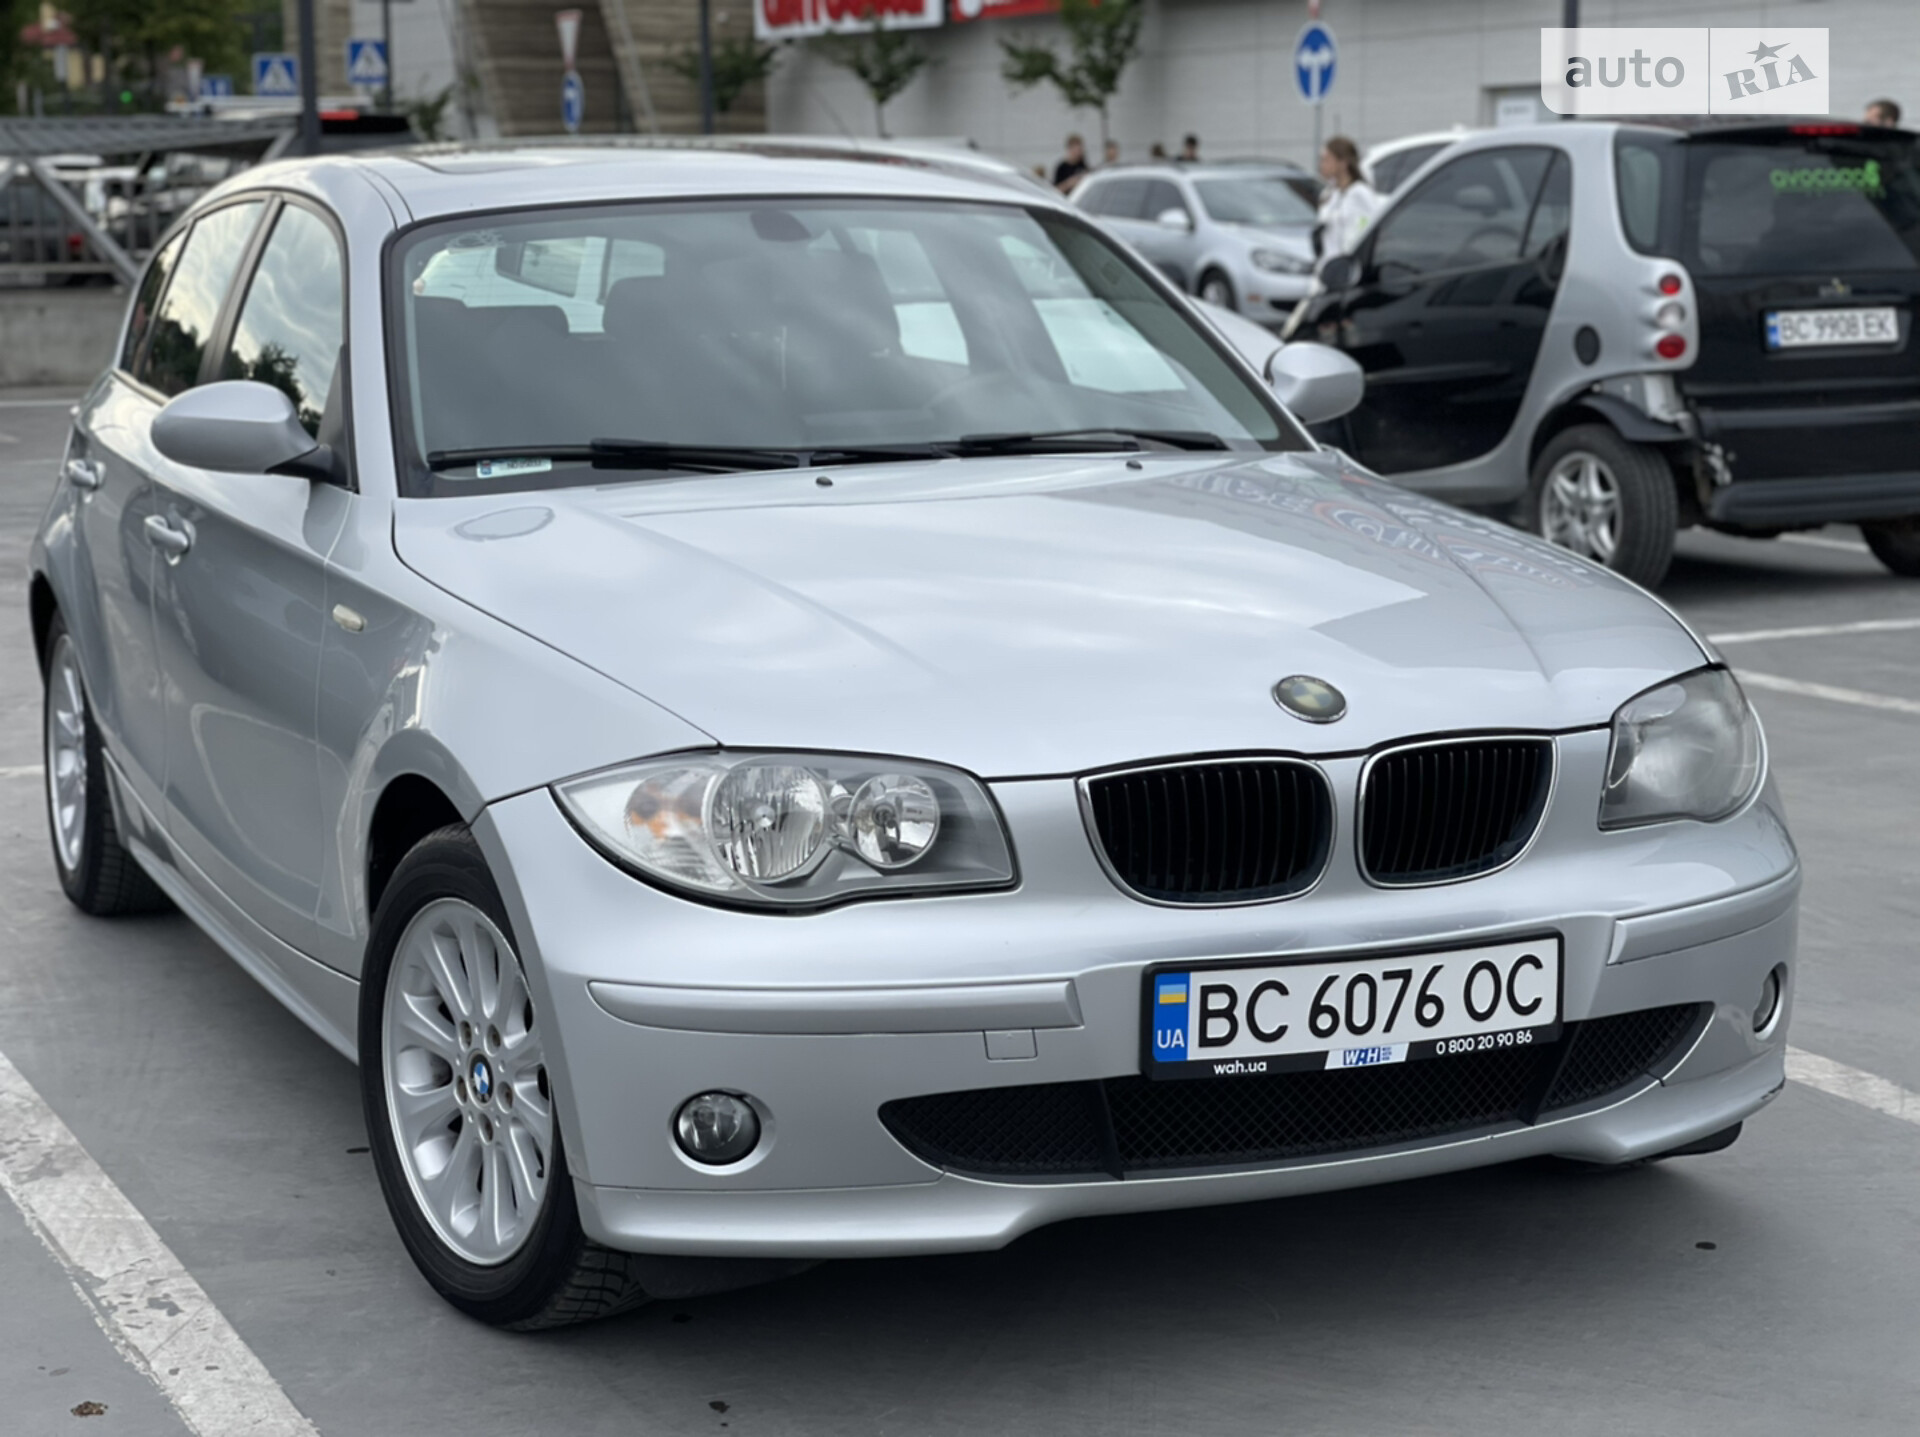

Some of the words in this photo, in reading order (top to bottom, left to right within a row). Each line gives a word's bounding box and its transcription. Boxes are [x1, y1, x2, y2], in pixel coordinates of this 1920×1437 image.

[1780, 315, 1809, 341] BC
[1863, 311, 1892, 337] EK
[1197, 979, 1290, 1048] BC
[1307, 964, 1445, 1039] 6076
[1463, 953, 1544, 1022] OC
[1156, 1029, 1185, 1049] UA
[1436, 1041, 1446, 1056] 0
[1448, 1037, 1475, 1053] 800
[1477, 1034, 1494, 1050] 20
[1496, 1032, 1514, 1047] 90
[1516, 1029, 1533, 1044] 86
[1213, 1060, 1267, 1075] wah.ua
